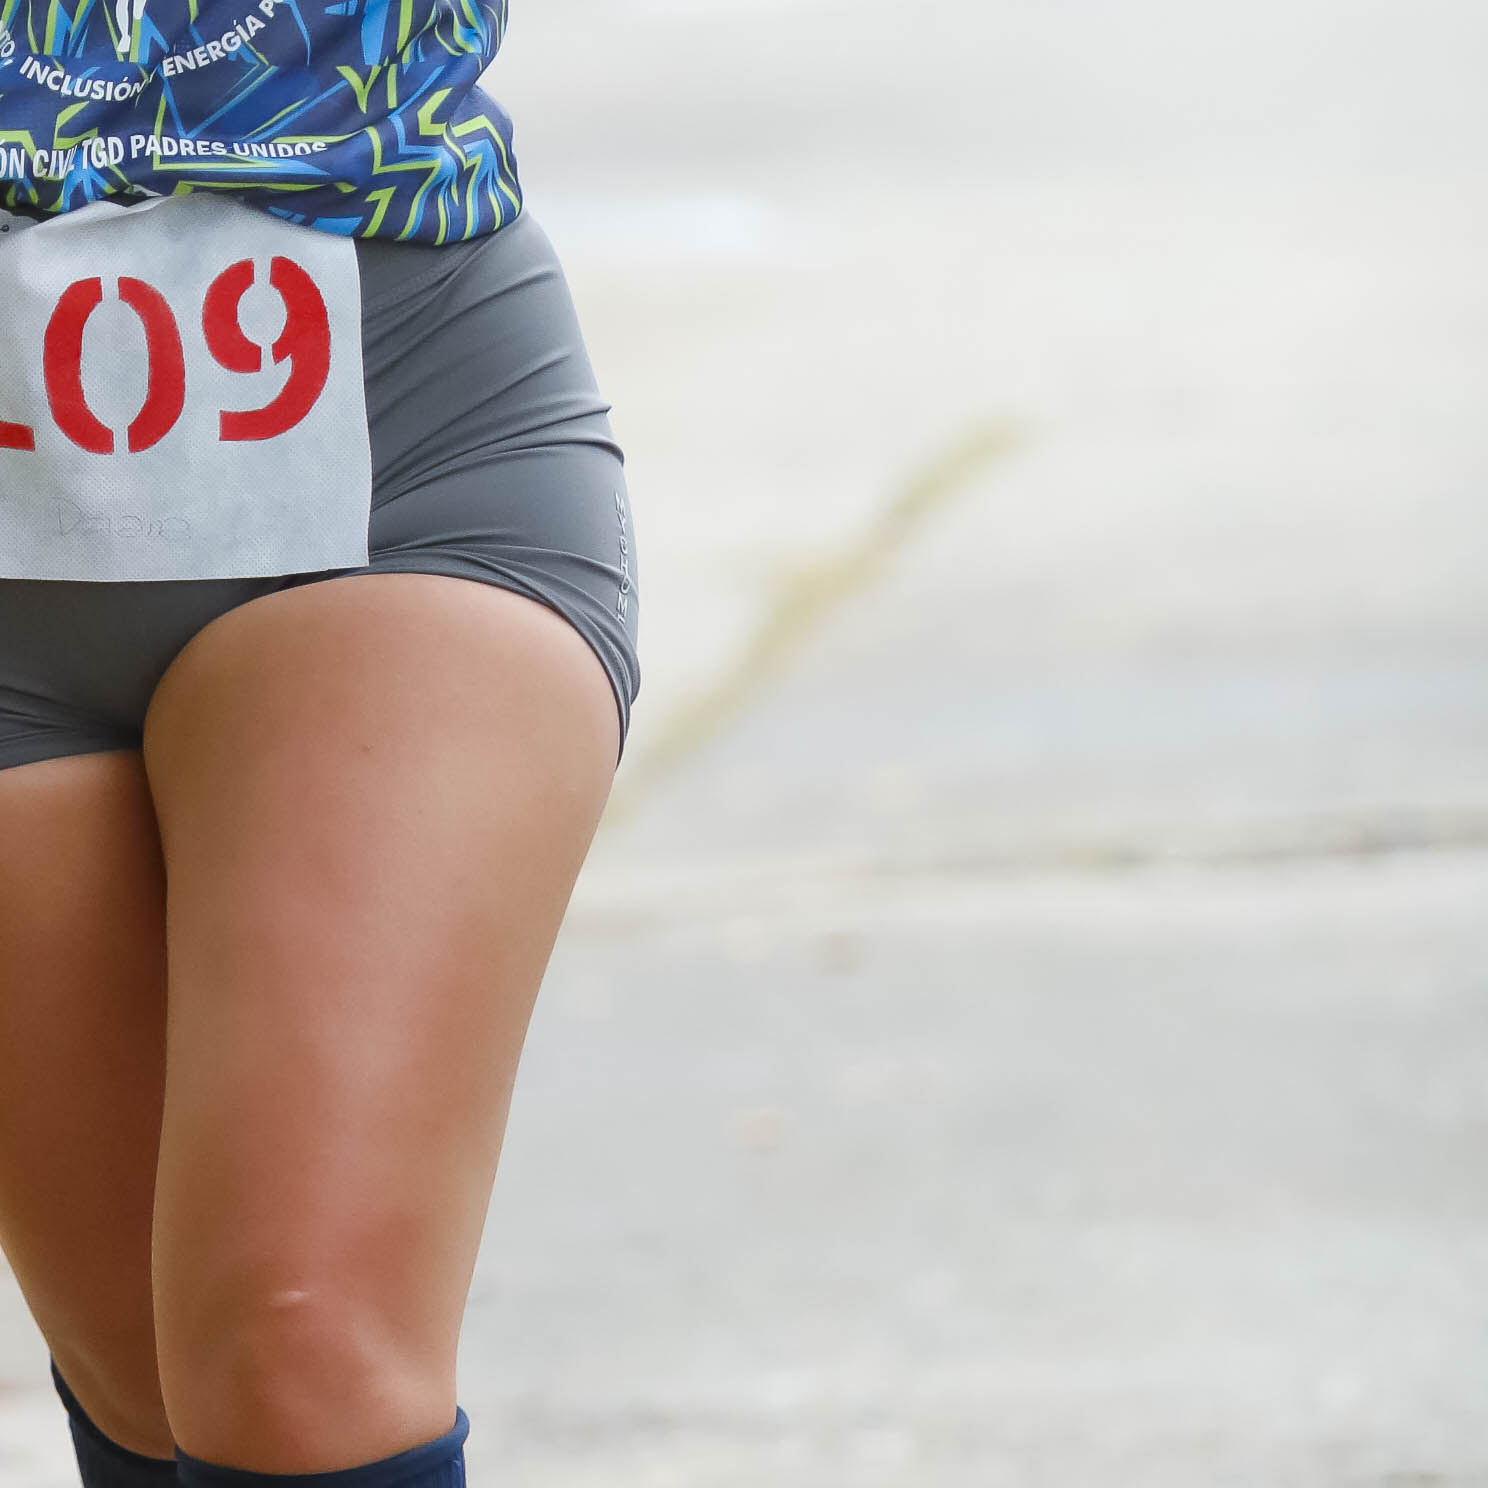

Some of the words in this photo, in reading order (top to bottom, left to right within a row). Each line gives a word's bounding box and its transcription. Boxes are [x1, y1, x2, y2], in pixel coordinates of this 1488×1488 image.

[18, 56, 147, 101] INCLUSIÓN
[162, 15, 267, 77] ENERGÍA
[81, 135, 125, 170] TGD
[129, 134, 228, 159] PADRES
